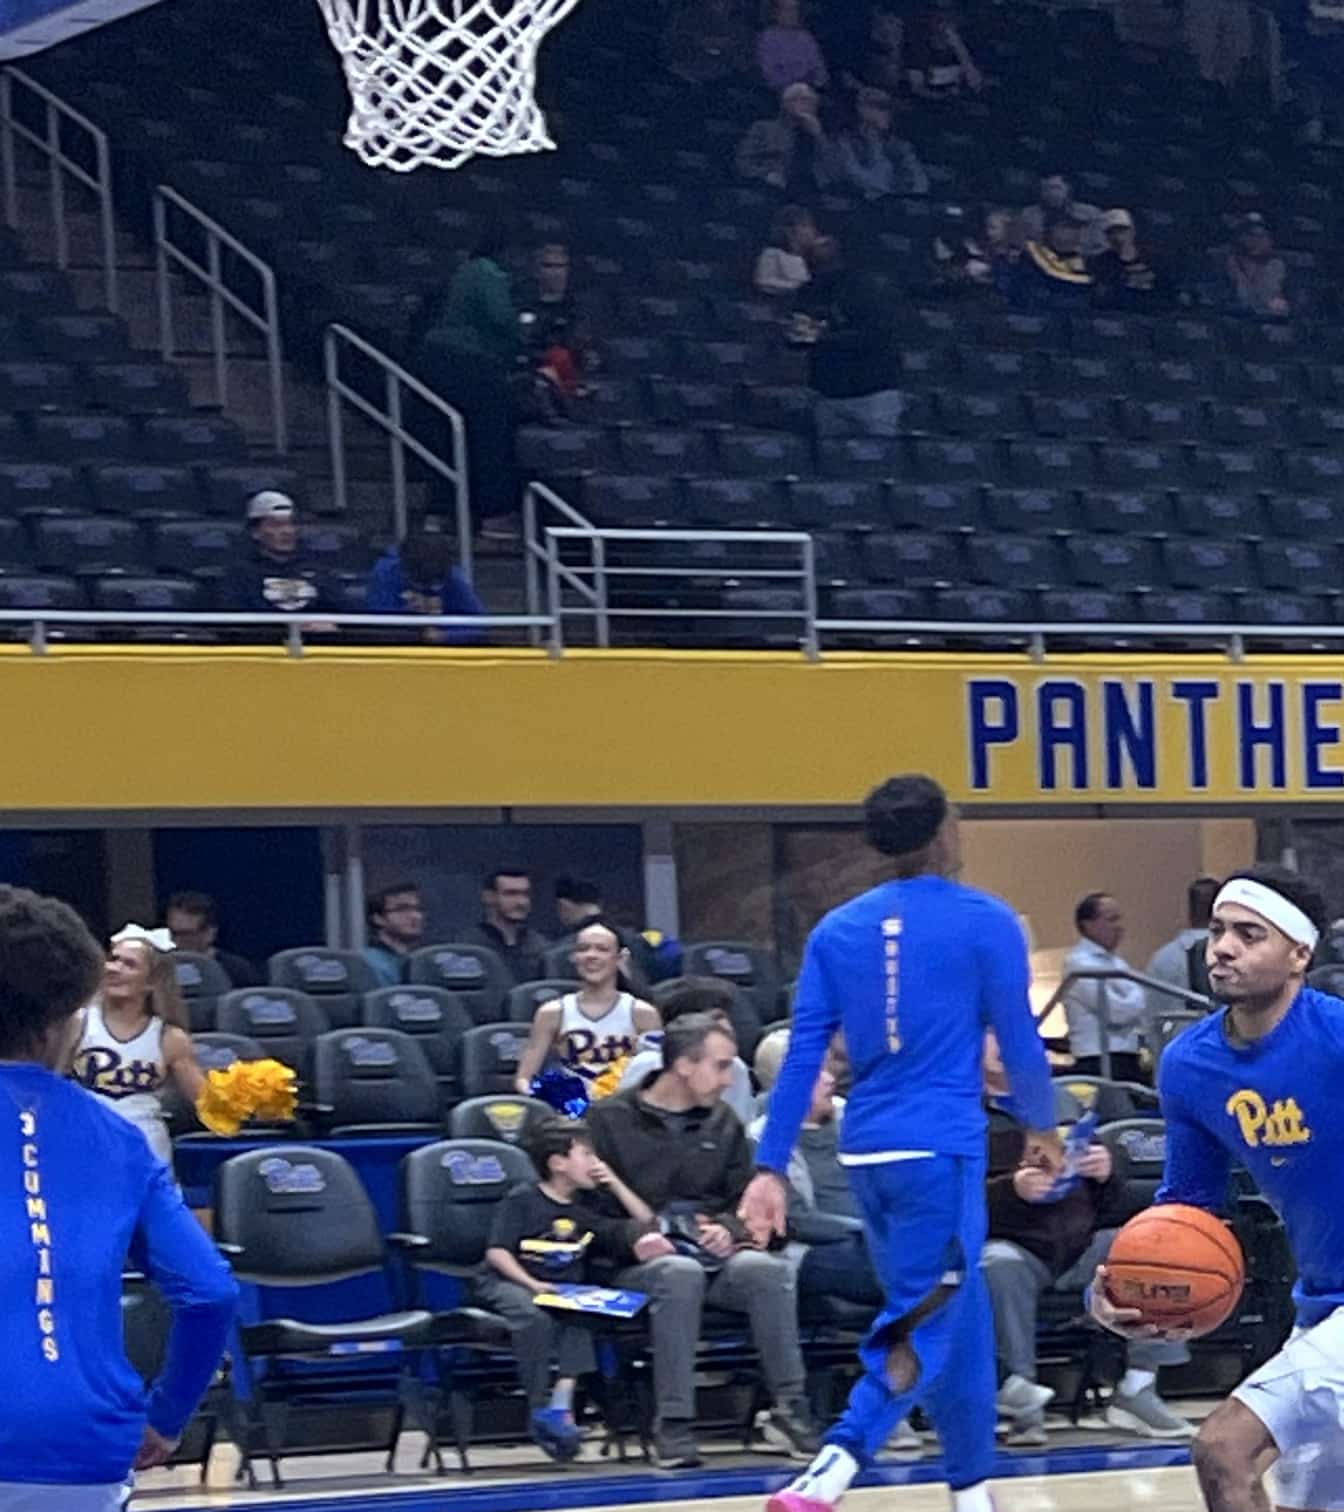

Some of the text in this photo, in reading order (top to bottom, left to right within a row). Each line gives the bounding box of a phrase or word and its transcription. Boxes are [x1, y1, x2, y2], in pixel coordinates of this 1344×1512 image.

[72, 1046, 162, 1099] Pitt
[561, 1029, 633, 1078] Pitt
[1226, 1088, 1312, 1147] Pitt
[22, 1143, 60, 1363] CUMMINGS
